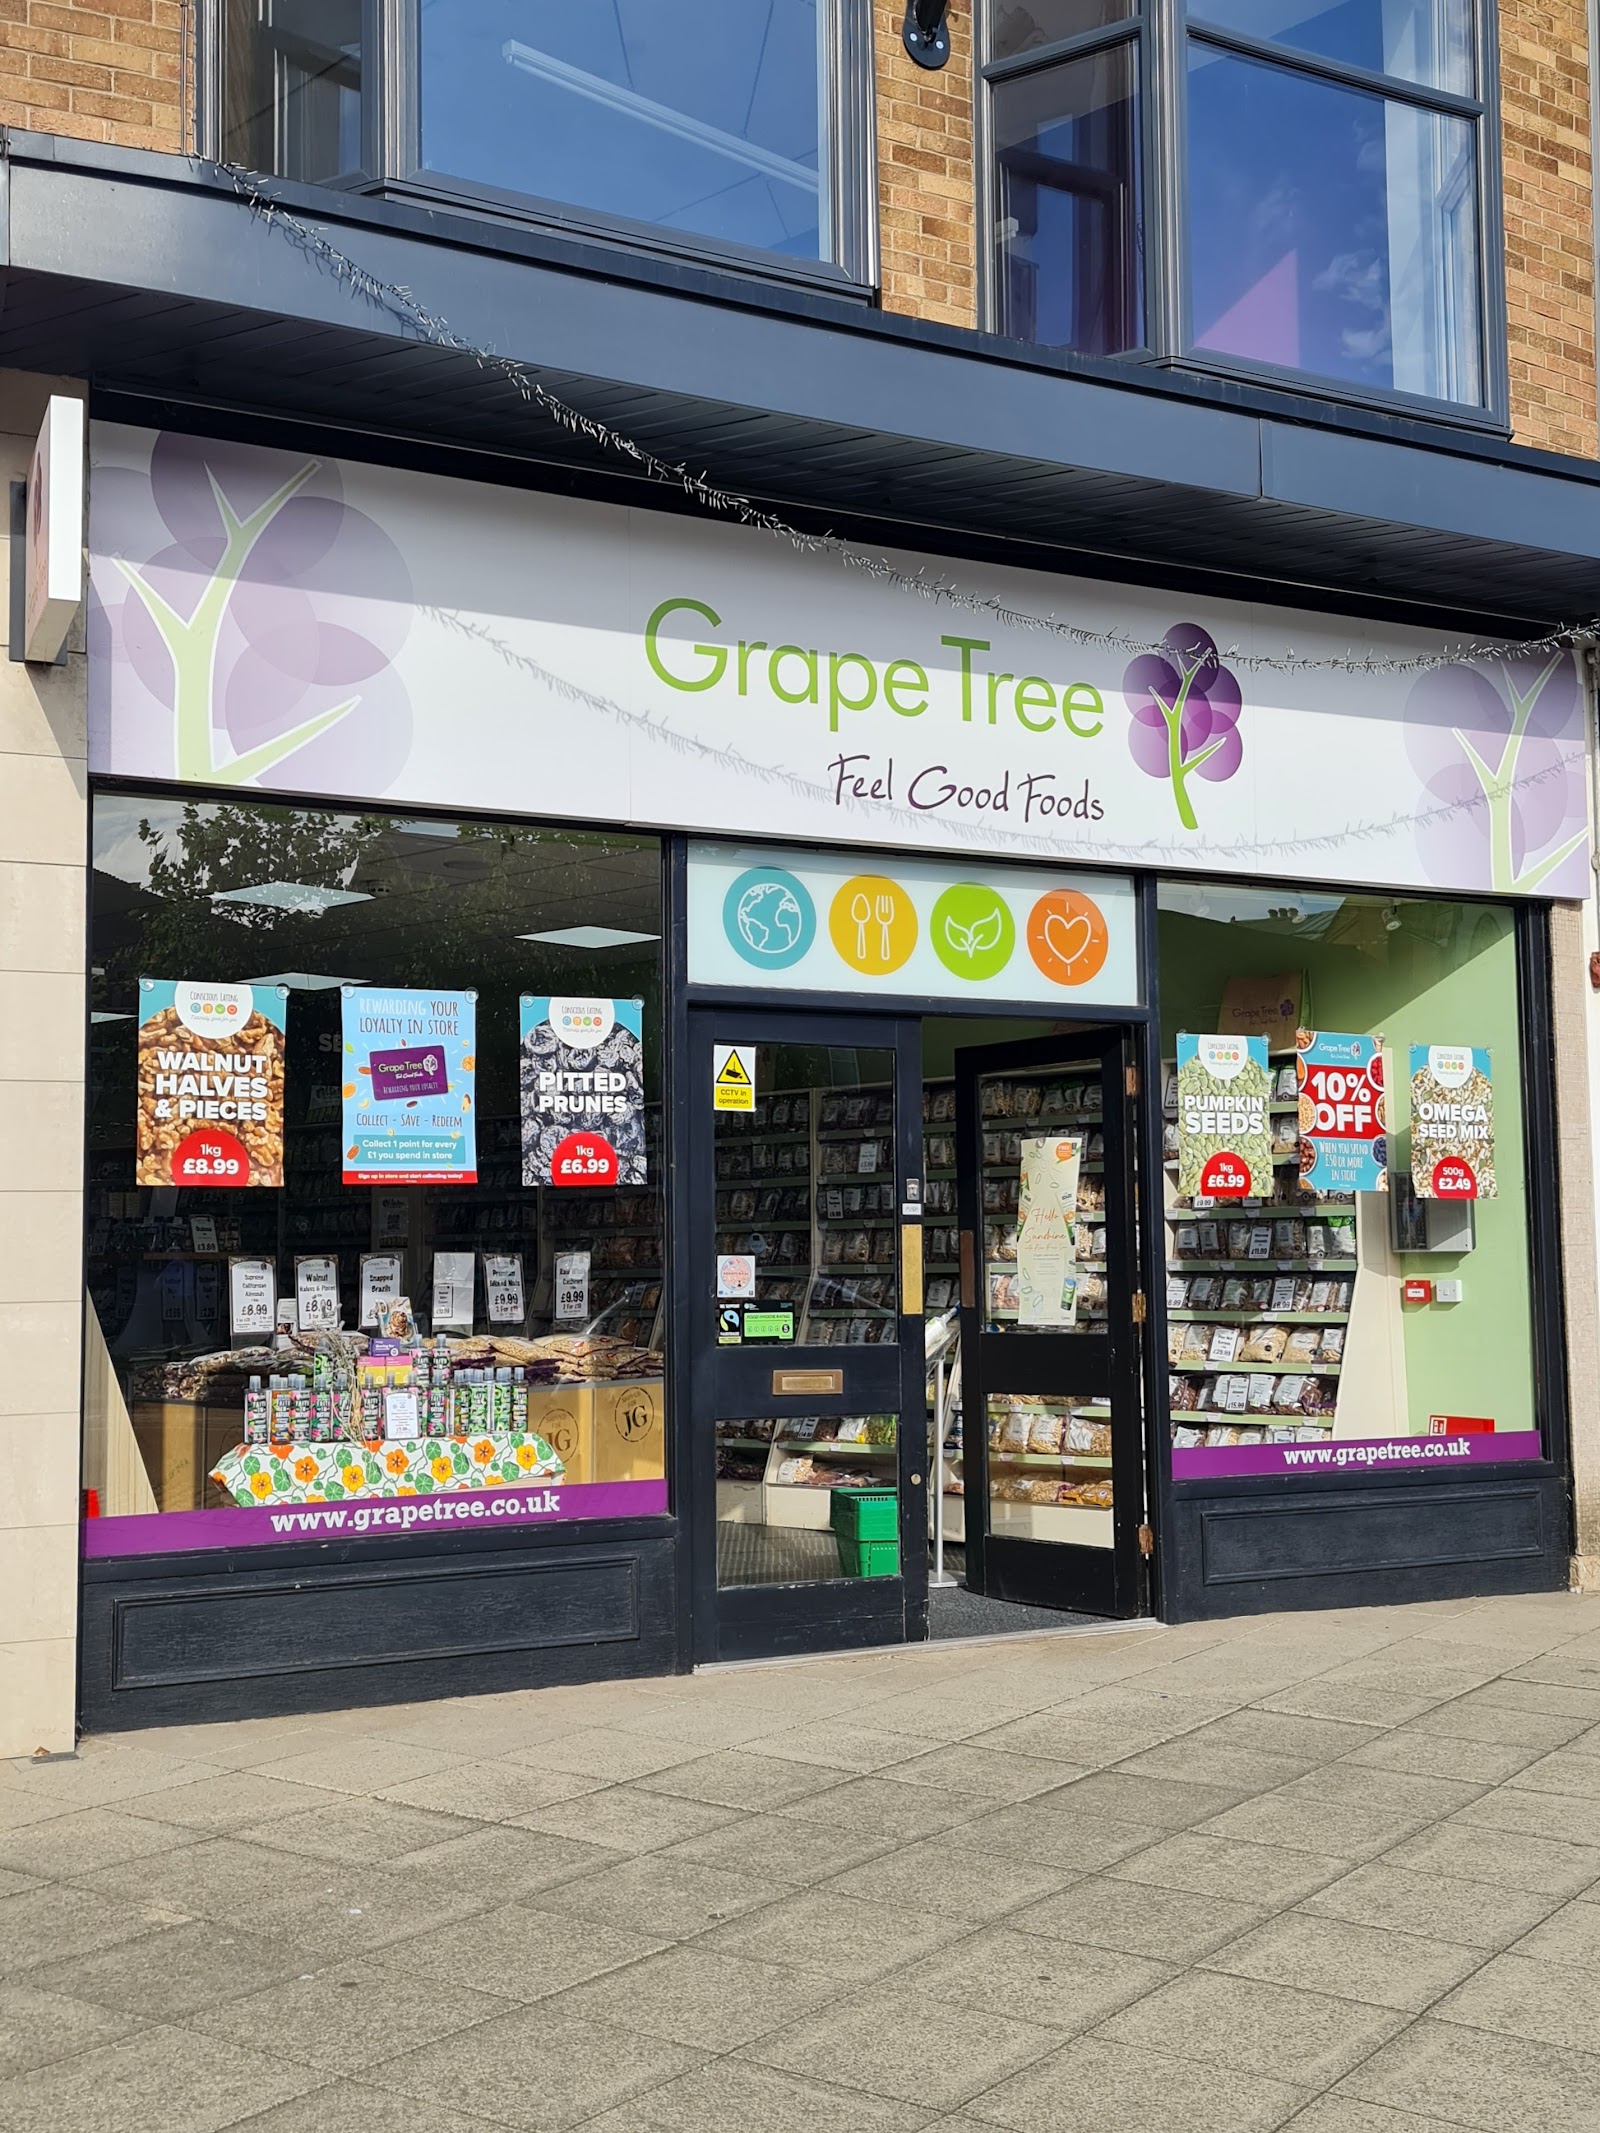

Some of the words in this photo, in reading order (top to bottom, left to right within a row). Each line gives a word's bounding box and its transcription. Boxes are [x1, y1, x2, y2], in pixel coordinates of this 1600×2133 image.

[645, 597, 929, 732] Grape
[940, 635, 1104, 738] Tree
[828, 753, 893, 806] Feel
[907, 765, 1009, 811] Good
[1016, 773, 1105, 823] Foods
[359, 998, 426, 1016] REWARDING
[430, 1000, 459, 1017] YOUR
[359, 1017, 403, 1034] LOYALTY
[407, 1019, 423, 1035] IN
[428, 1019, 459, 1036] STORE
[1319, 1042, 1338, 1053] Grape
[1337, 1043, 1351, 1053] Tree
[157, 1051, 267, 1074] WALNUT
[378, 1063, 405, 1073] Grape
[405, 1060, 422, 1070] Tree
[155, 1074, 268, 1099] HALVES
[539, 1072, 627, 1092] PITTED
[1311, 1071, 1371, 1103] 10%
[720, 1088, 739, 1096] CCTV
[539, 1095, 627, 1113] PRUNES
[718, 1097, 749, 1105] operation
[1184, 1095, 1264, 1112] PUMPKIN
[154, 1098, 172, 1118] &
[179, 1101, 268, 1121] PIECES
[1315, 1102, 1372, 1133] OFF
[1418, 1103, 1489, 1122] OMEGA
[1185, 1111, 1264, 1135] SEEDS
[1419, 1124, 1457, 1139] SEED
[1460, 1124, 1489, 1140] MIX
[200, 1143, 222, 1158] 1kg
[362, 1139, 391, 1148] Collect
[399, 1140, 420, 1149] point
[421, 1140, 433, 1148] for
[434, 1141, 457, 1150] every
[575, 1145, 594, 1157] 1kg
[1318, 1140, 1337, 1154] WHEN
[1338, 1142, 1350, 1154] YOU
[1350, 1143, 1369, 1155] SPEND
[367, 1151, 377, 1159] £1
[378, 1153, 394, 1161] you
[395, 1151, 422, 1161] spend
[422, 1151, 431, 1159] in
[431, 1152, 453, 1160] store
[1325, 1153, 1337, 1167] £50
[1338, 1156, 1346, 1168] OR
[1347, 1156, 1364, 1169] MORE
[183, 1158, 239, 1175] £8.99
[560, 1158, 609, 1174] £6.99
[1219, 1162, 1234, 1173] 1kg
[1442, 1166, 1465, 1177] 500g
[1207, 1174, 1245, 1187] £6.99
[1331, 1169, 1340, 1181] IN
[1340, 1169, 1357, 1182] STORE
[1438, 1177, 1471, 1190] £2.49
[1031, 1208, 1060, 1226] Hello
[1025, 1228, 1067, 1244] Sunshine
[305, 1273, 329, 1282] Walnut
[369, 1273, 394, 1282] Snapped
[371, 1284, 391, 1293] Brazils
[560, 1290, 584, 1304] £9.99
[241, 1303, 268, 1316] £8.99
[783, 1324, 788, 1333] 5
[622, 1405, 648, 1437] JG
[1283, 1437, 1471, 1466] www.grapetree.co.uk
[270, 1490, 561, 1532] www.grapetree.co.uk
